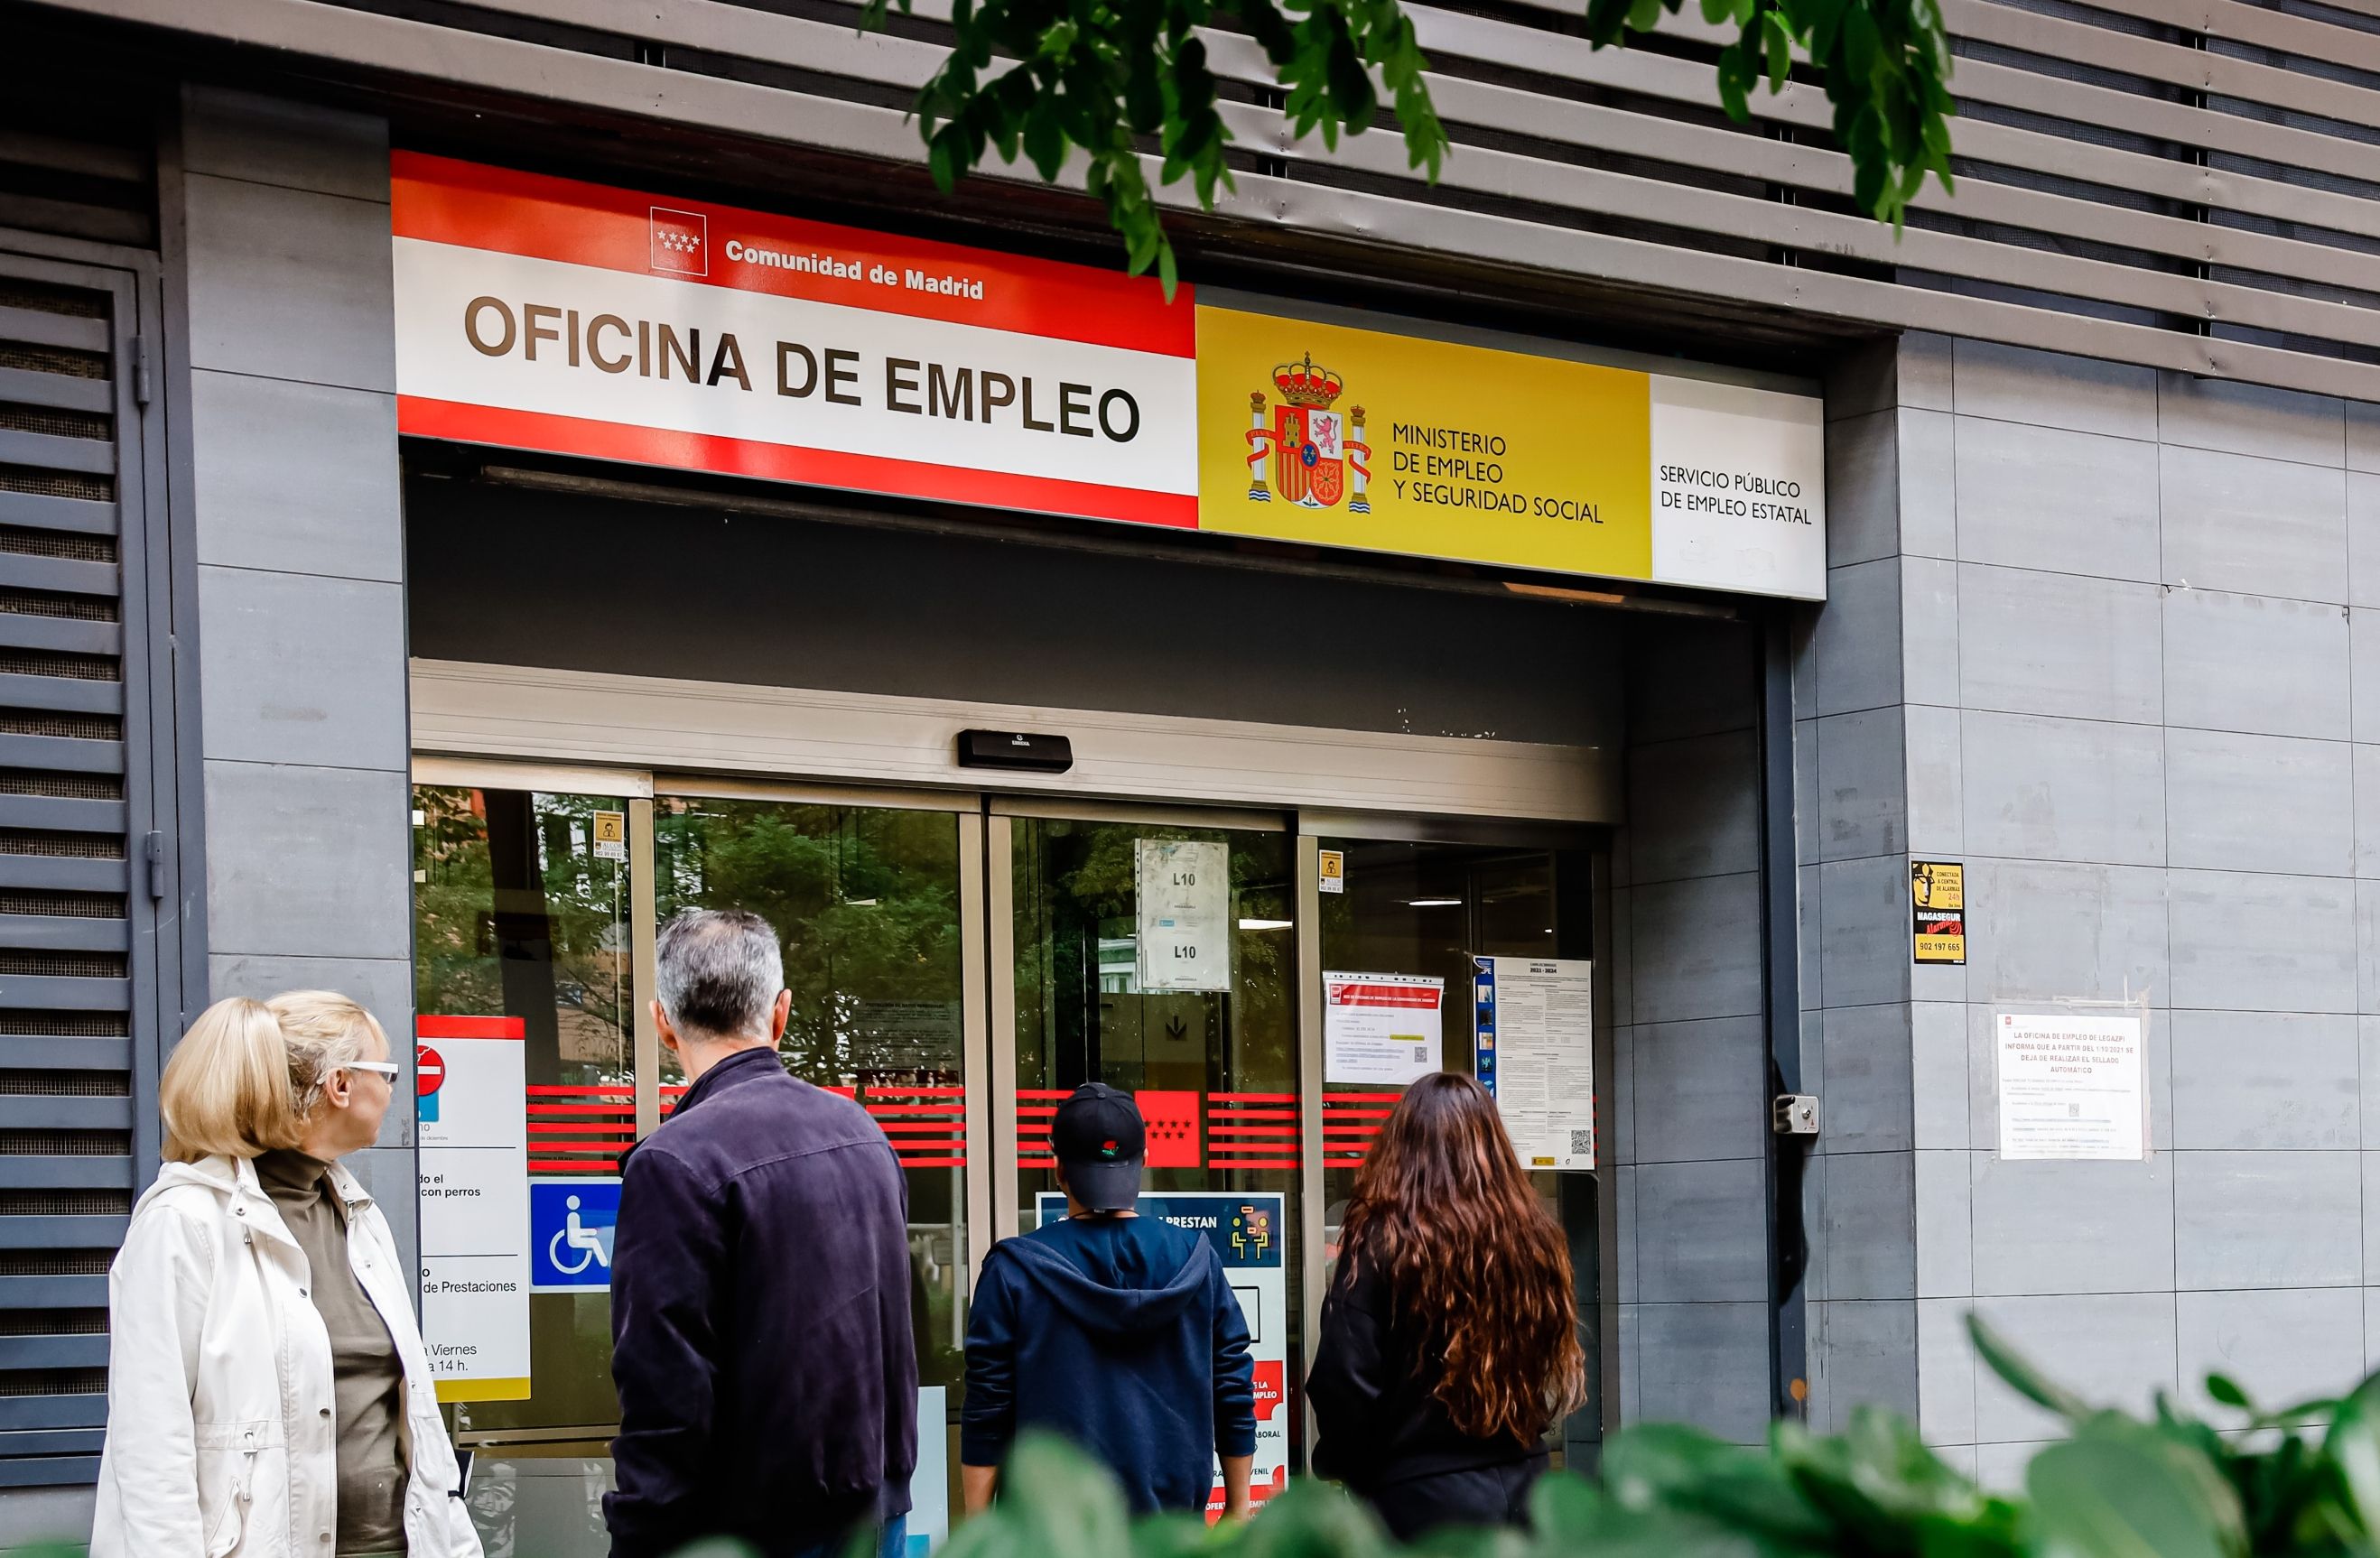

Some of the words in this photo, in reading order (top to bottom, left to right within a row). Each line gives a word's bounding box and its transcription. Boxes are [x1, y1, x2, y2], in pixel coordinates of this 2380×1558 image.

[726, 240, 861, 282] Comunidad
[870, 260, 897, 287] de
[906, 269, 983, 301] Madrid
[465, 296, 752, 392] OFICINA
[776, 341, 861, 406] DE
[887, 357, 1139, 443] EMPLEO
[1393, 423, 1506, 457] MINISTERIO
[1394, 453, 1421, 474] DE
[1427, 455, 1502, 484] EMPLEO
[1660, 466, 1728, 489] SERVICIO
[1734, 471, 1799, 498] PÚBLICO
[1394, 479, 1406, 499] Y
[1413, 484, 1527, 513] SEGURIDAD
[1533, 496, 1604, 524] SOCIAL
[1661, 489, 1684, 508] DE
[1687, 493, 1746, 516] EMPLEO
[1752, 502, 1812, 525] ESTATAL
[1174, 873, 1195, 886] L10
[1948, 893, 1960, 901] 24h
[1917, 912, 1961, 921] MAGASEGUR
[1175, 946, 1196, 959] L10
[1920, 942, 1932, 951] 902
[1935, 942, 1946, 951] 197
[1948, 943, 1960, 951] 665
[2098, 1034, 2125, 1043] LEGAZPI
[2092, 1056, 2119, 1064] SELLADO
[433, 1173, 443, 1184] el
[422, 1189, 442, 1197] con
[445, 1189, 481, 1199] perros
[423, 1282, 439, 1294] de
[442, 1280, 517, 1294] Prestaciones
[432, 1344, 478, 1356] Viernes
[439, 1359, 453, 1372] 14
[457, 1359, 469, 1371] h.
[1259, 1381, 1269, 1389] LA
